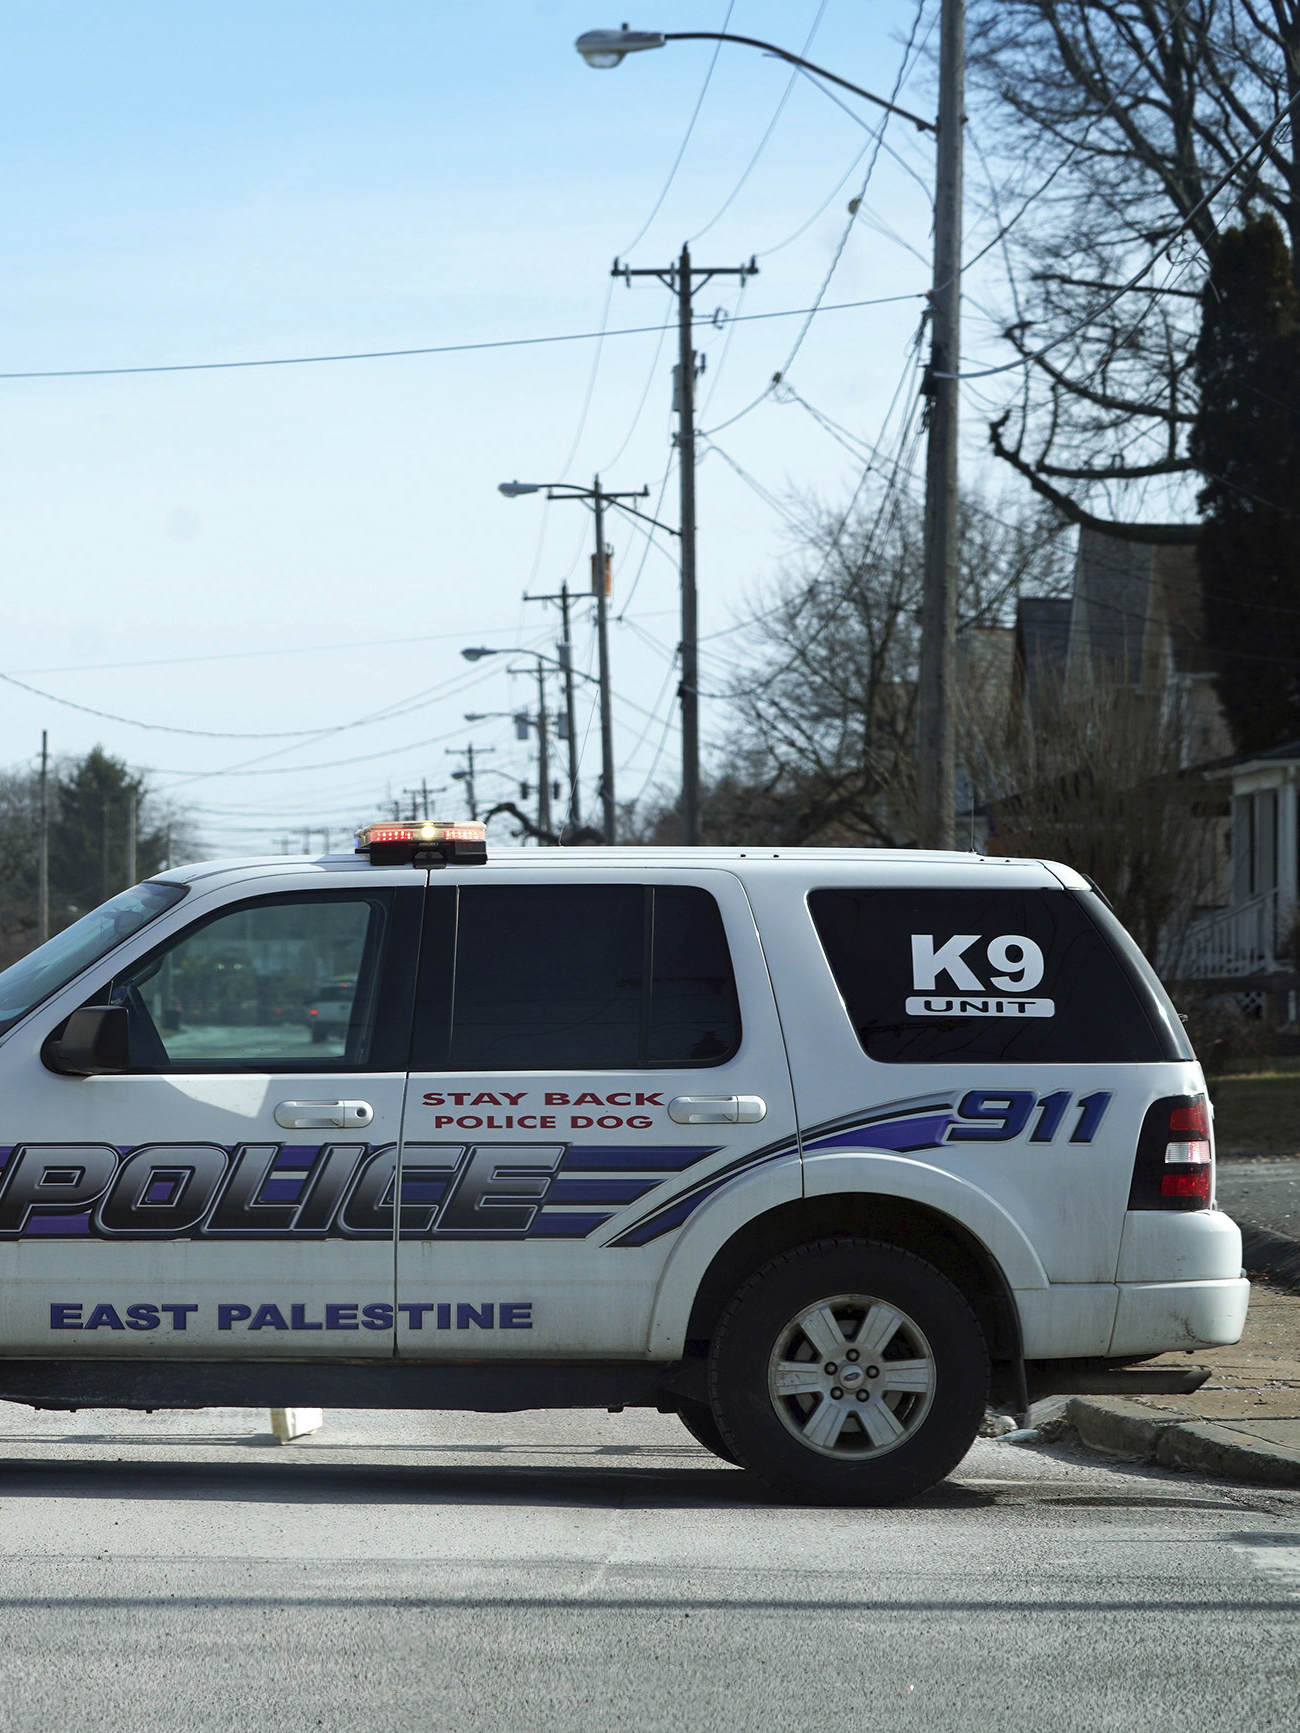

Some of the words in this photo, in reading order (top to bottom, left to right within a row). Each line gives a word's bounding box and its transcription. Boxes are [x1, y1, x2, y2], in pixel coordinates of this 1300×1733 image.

[911, 934, 1045, 993] K9
[923, 999, 1037, 1014] UNIT
[422, 1092, 529, 1106] STAY
[544, 1092, 665, 1107] BACK
[434, 1115, 556, 1129] POLICE
[570, 1115, 654, 1130] DOG
[946, 1089, 1114, 1143] 911
[49, 1303, 199, 1331] EAST
[217, 1302, 534, 1330] PALESTINE
